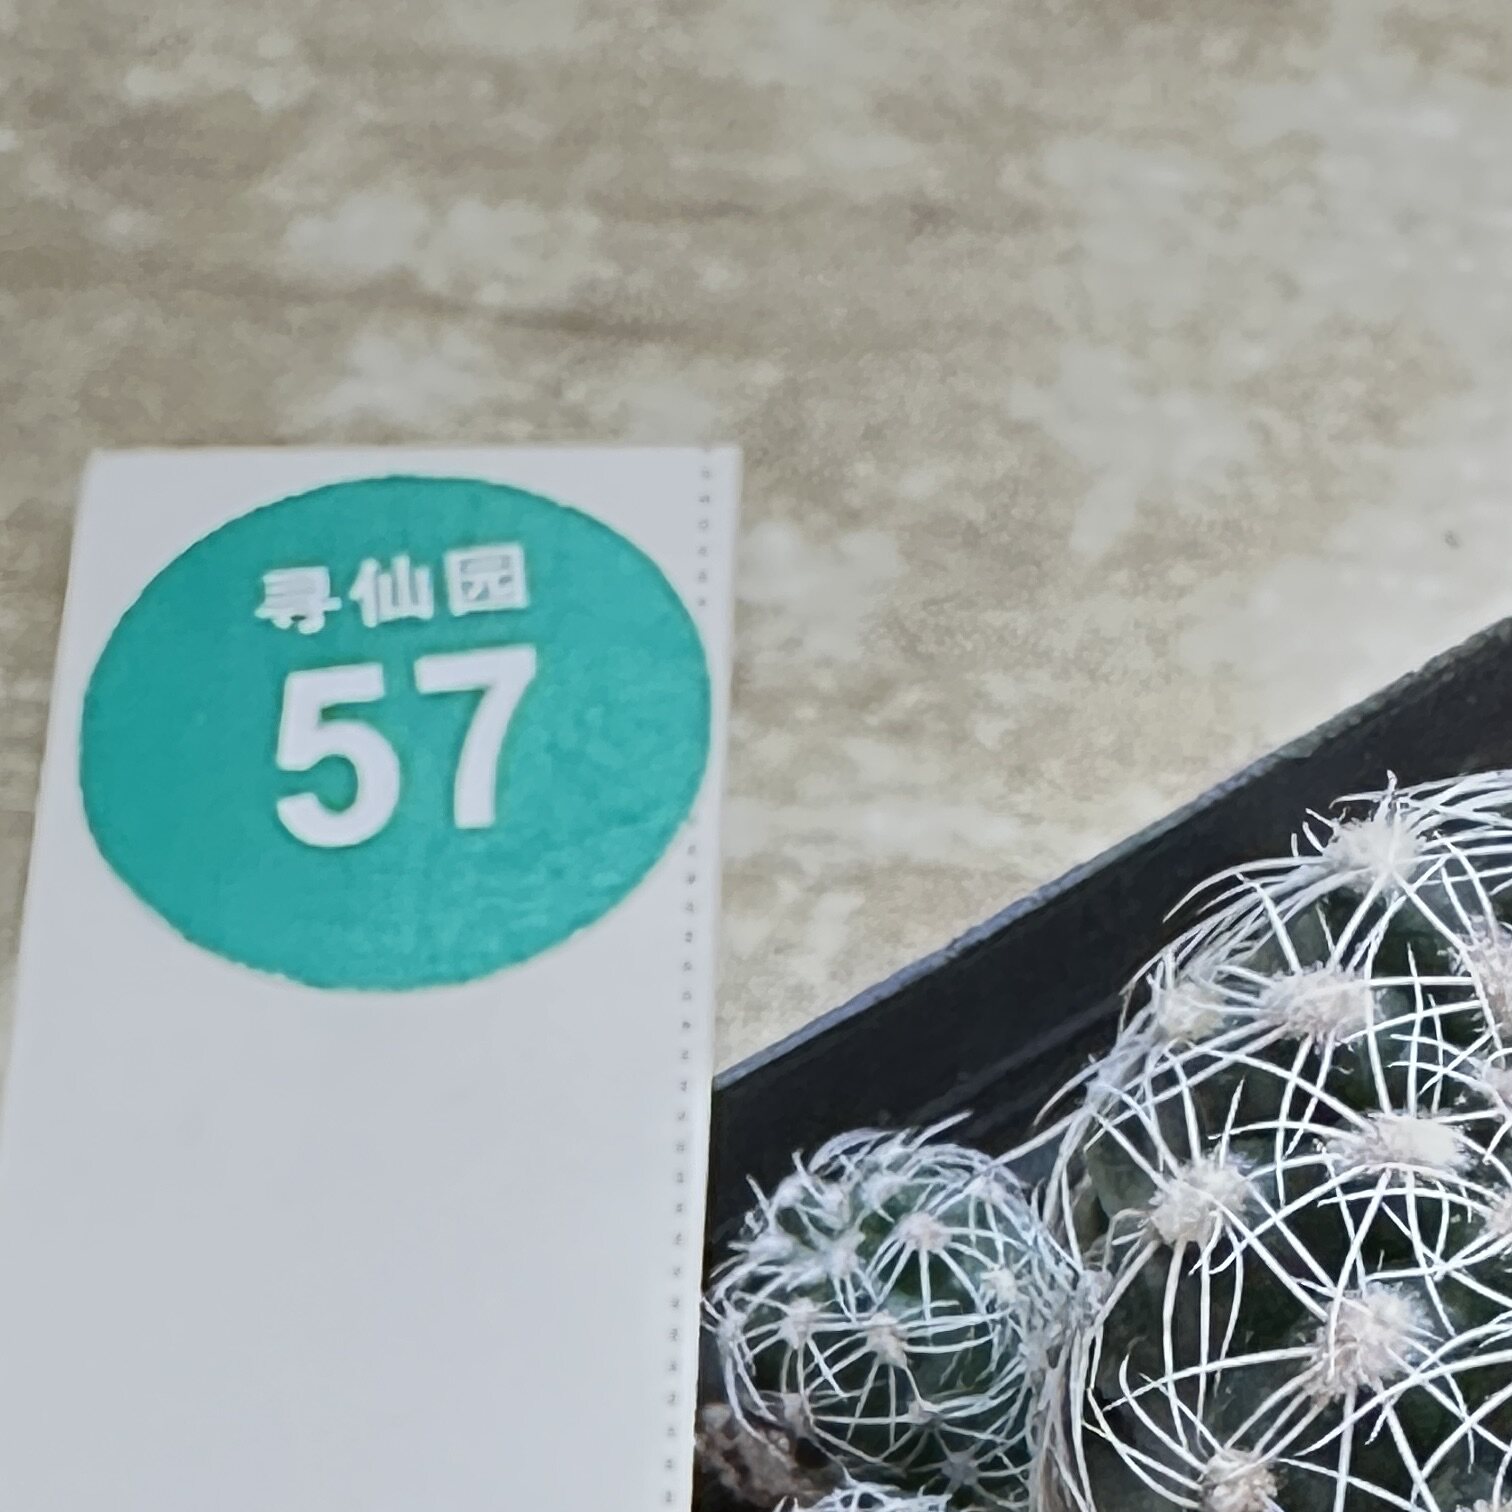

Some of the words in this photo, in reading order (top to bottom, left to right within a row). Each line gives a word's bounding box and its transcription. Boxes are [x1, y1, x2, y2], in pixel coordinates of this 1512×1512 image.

[254, 542, 530, 635] 寻仙园
[275, 643, 537, 848] 57
